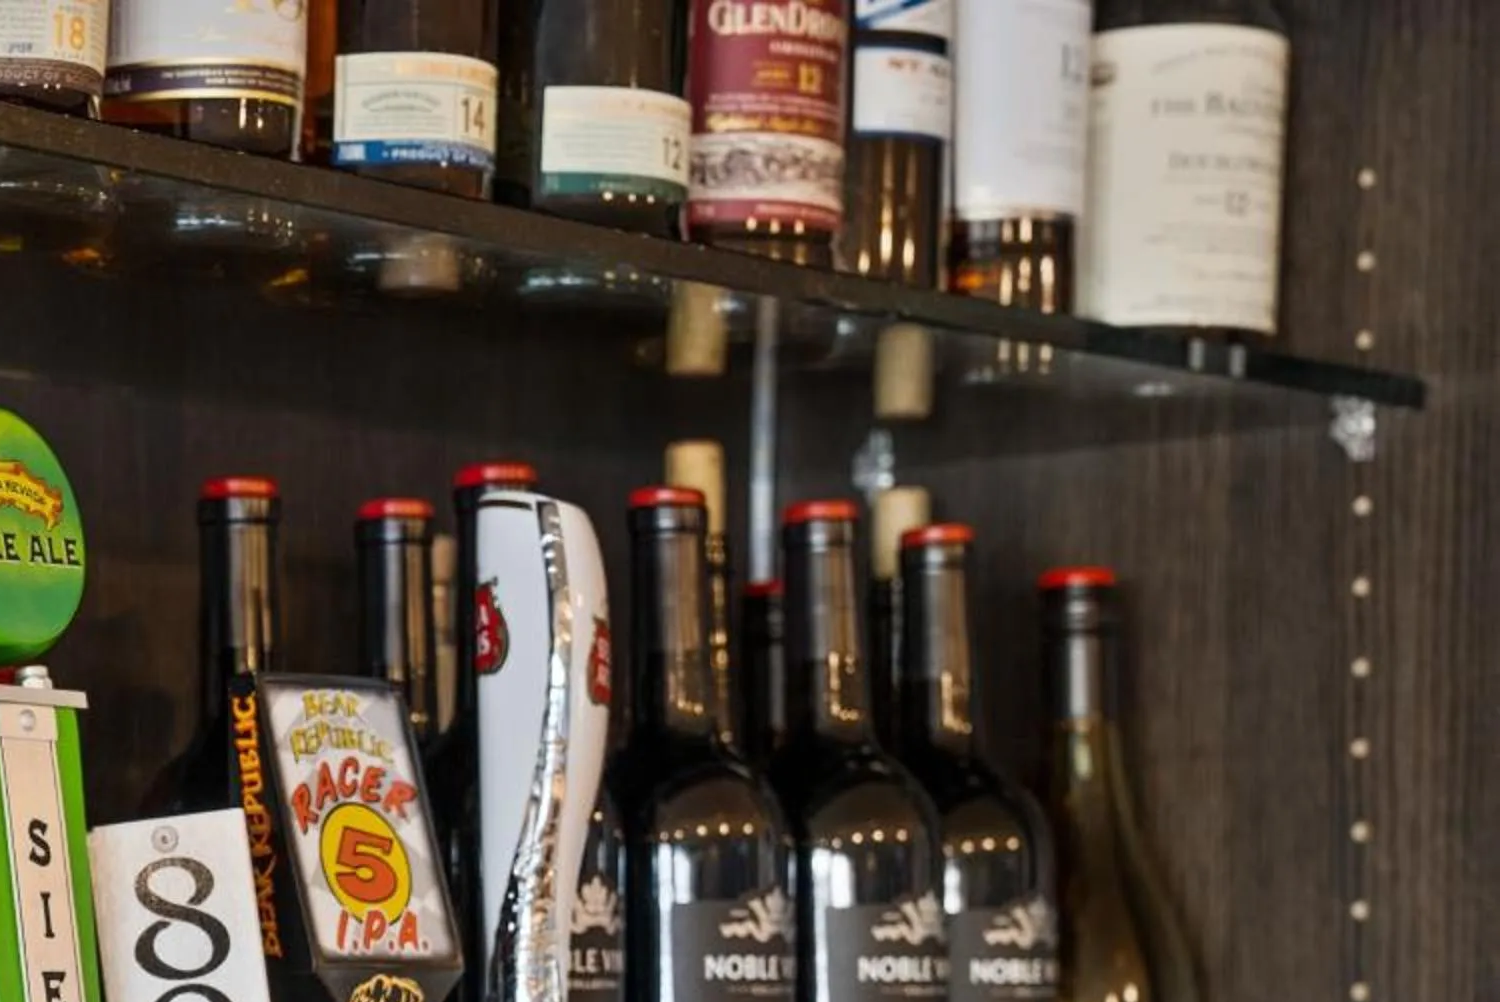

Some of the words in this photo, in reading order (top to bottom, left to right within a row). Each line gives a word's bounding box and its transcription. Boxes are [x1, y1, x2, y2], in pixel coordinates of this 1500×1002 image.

[54, 13, 86, 50] 18
[461, 97, 486, 136] 14
[29, 533, 81, 567] ALE
[303, 689, 361, 719] BEAR
[232, 694, 274, 857] REPUBLIC
[291, 756, 417, 835] RACER
[336, 826, 397, 904] 5
[336, 908, 429, 951] I.P.A.
[704, 954, 779, 981] NOBLE
